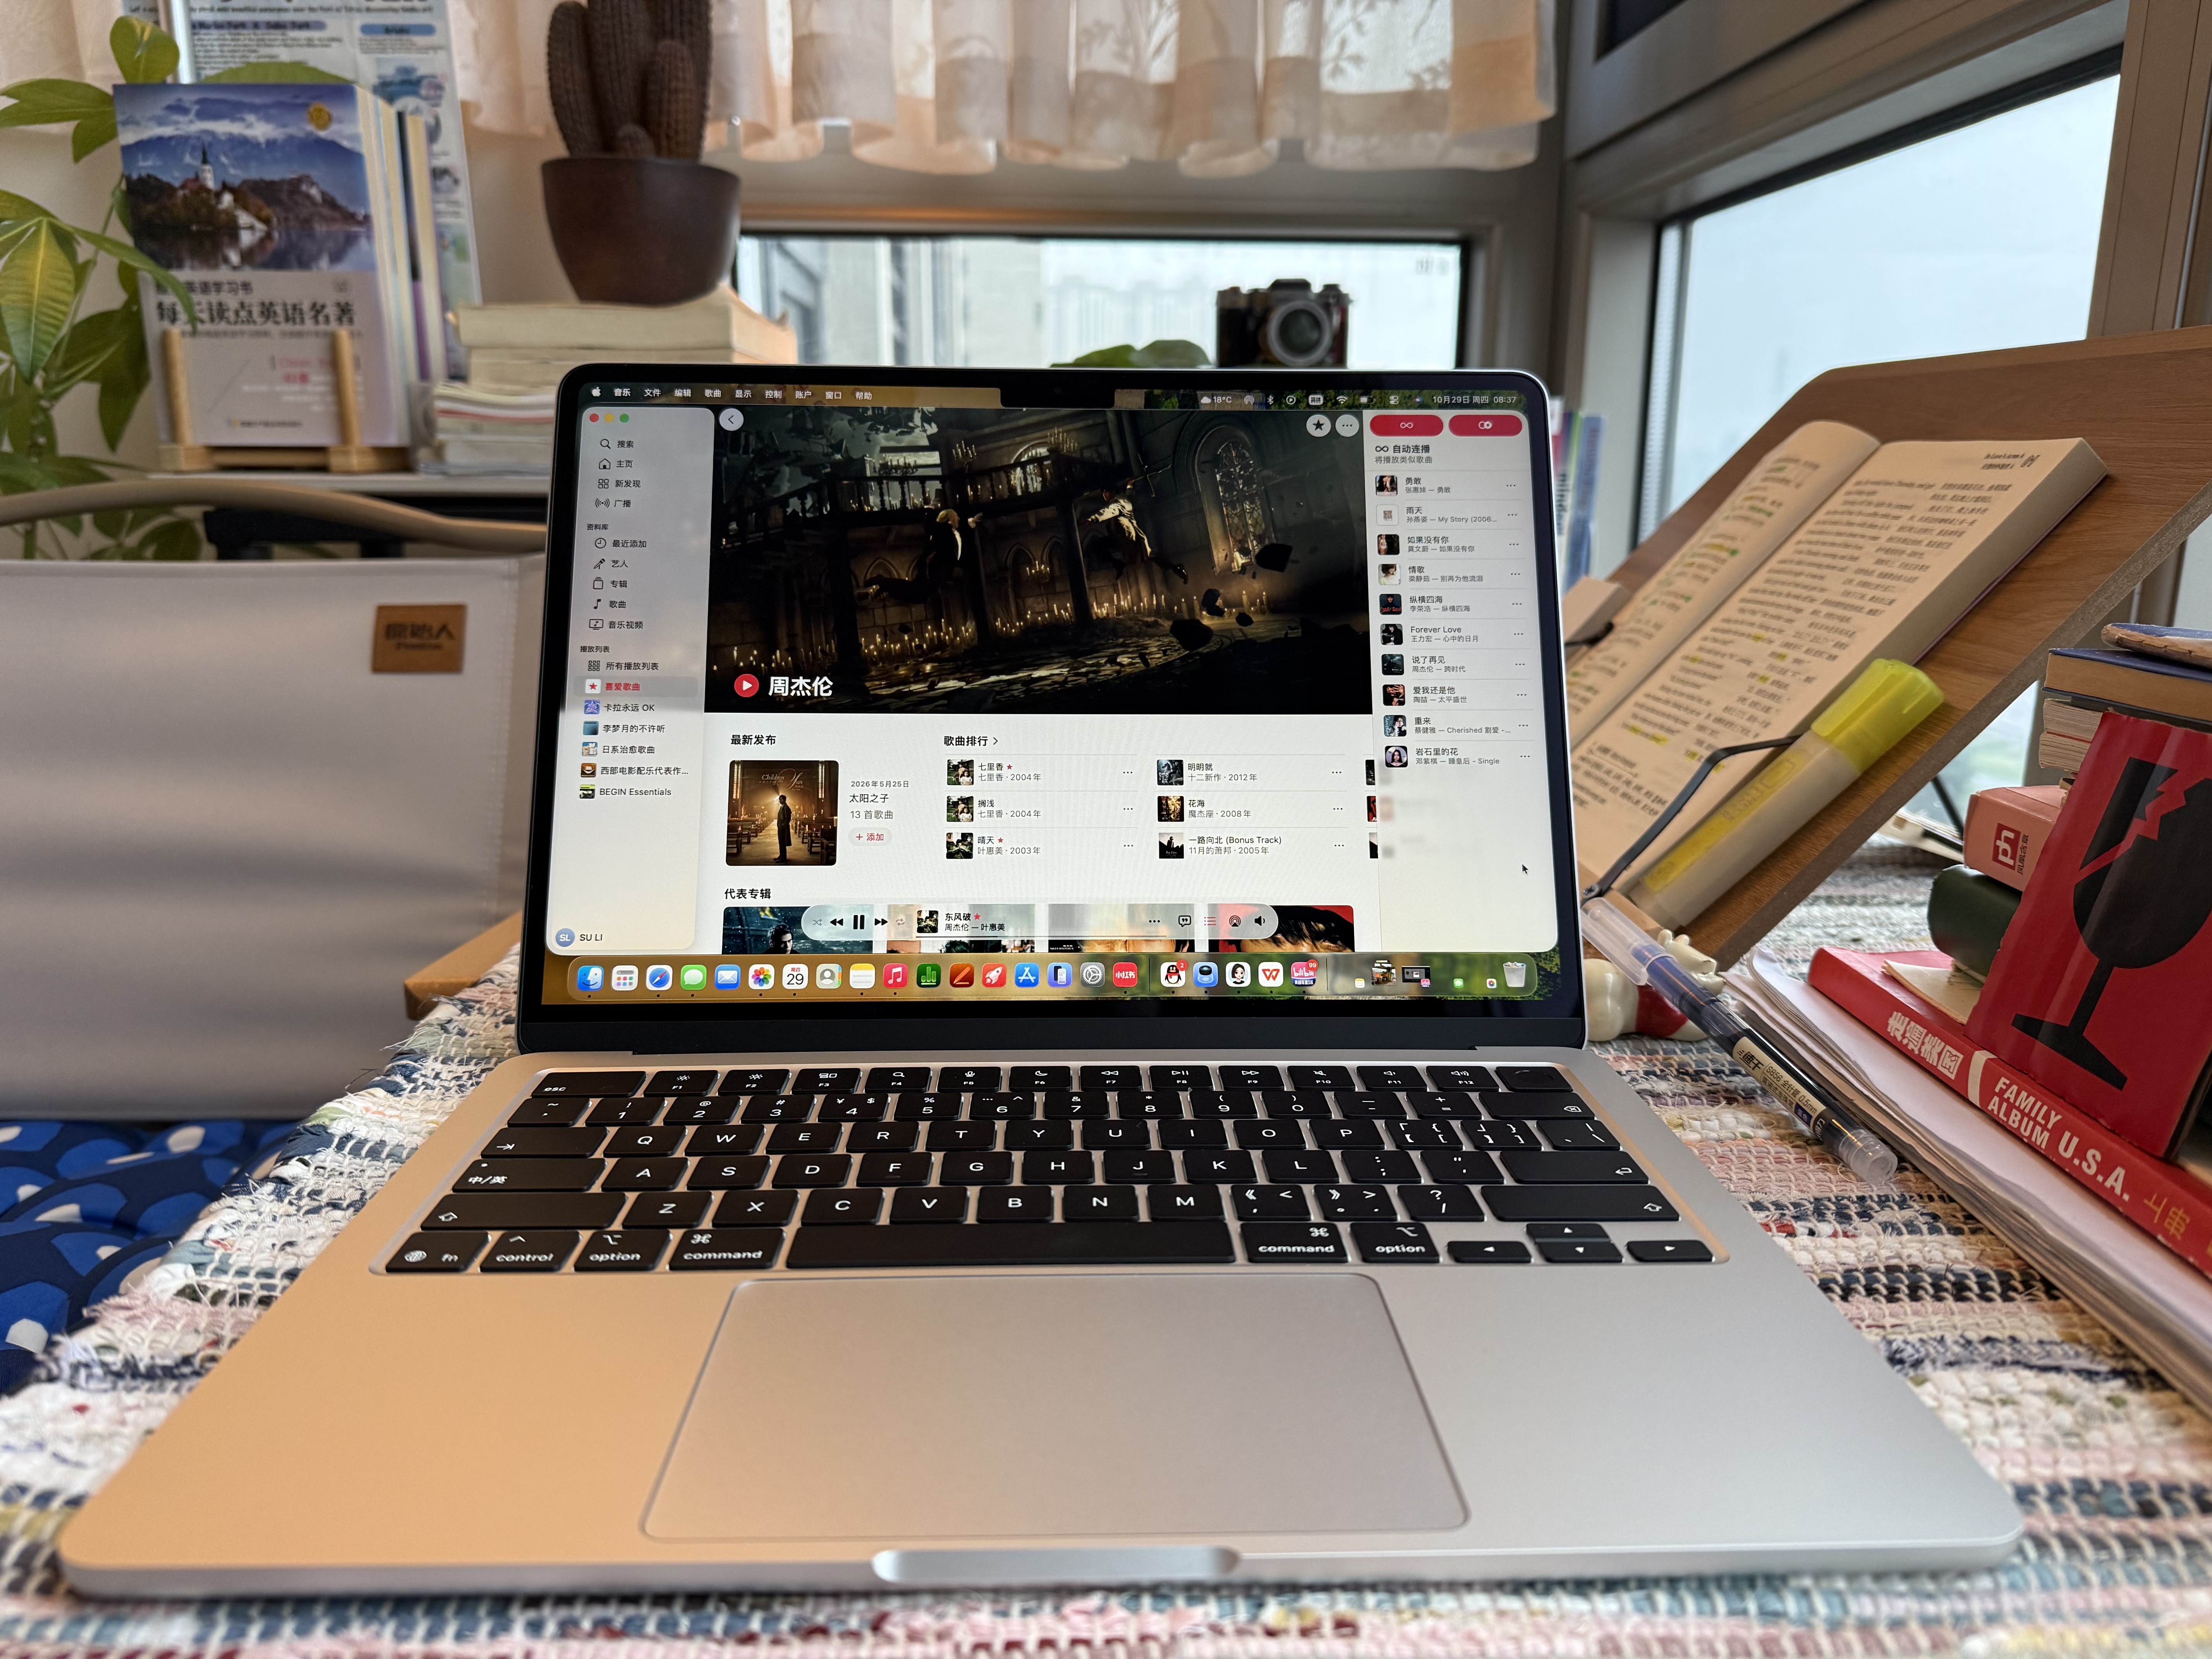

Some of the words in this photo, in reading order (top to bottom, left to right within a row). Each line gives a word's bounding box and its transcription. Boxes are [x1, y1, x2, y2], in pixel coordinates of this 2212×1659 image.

[614, 388, 631, 397] 音乐
[644, 389, 661, 397] 文件
[674, 389, 692, 397] 编辑
[705, 390, 721, 398] 歌曲
[735, 390, 752, 398] 显示
[765, 390, 782, 399] 控制
[795, 391, 812, 399] 账户
[825, 391, 842, 400] 窗口
[855, 392, 872, 400] 帮助
[1432, 396, 1469, 404] 10月29日
[1472, 396, 1489, 404] 周四
[617, 440, 634, 448] 搜索
[1393, 445, 1430, 453] 自动连播
[615, 479, 641, 488] 新发现
[1405, 477, 1421, 485] 勇敢
[614, 499, 631, 508] 广播
[612, 540, 647, 548] 最近添加
[1407, 536, 1449, 544] 如果没有你
[612, 560, 629, 568] 艺人
[1408, 566, 1425, 574] 情歌
[1409, 596, 1443, 604] 纵横四海
[609, 601, 626, 609] 歌曲
[608, 621, 643, 629] 音乐视频
[1412, 656, 1446, 664] 说了再见
[606, 662, 659, 671] 所有播放列表
[605, 683, 640, 691] 喜爱歌曲
[768, 676, 833, 697] 周杰伦
[1413, 686, 1455, 694] 爱我还是他
[1414, 717, 1431, 725] 重来
[603, 725, 665, 733] 李梦月的不许听
[731, 735, 776, 745] 最新发布
[944, 736, 988, 746] 歌曲排行
[603, 746, 655, 754] 日系治愈歌曲
[1415, 748, 1458, 756] 岩石里的花
[978, 763, 1004, 771] 七里香
[1188, 763, 1213, 771] 明明就
[1188, 773, 1221, 781] 十二新作
[1228, 773, 1257, 781] 2012年
[849, 794, 889, 803] 太阳之子
[977, 799, 995, 807] 搁浅
[1188, 799, 1205, 807] 花海
[864, 810, 893, 819] 首歌曲
[977, 810, 1003, 818] 七里香
[1010, 810, 1041, 818] 2004年
[1188, 810, 1214, 818] 魔杰座
[1221, 810, 1251, 818] 2008年
[866, 833, 884, 841] 添加
[977, 836, 994, 845] 晴天
[1188, 836, 1223, 845] 一路向北
[1226, 836, 1254, 845] (Bonus
[1257, 836, 1282, 845] Track)
[977, 847, 1003, 855] 叶惠美
[1010, 847, 1041, 855] 2003年
[1996, 829, 2015, 866] ph
[2017, 833, 2030, 875] 凤凰含章
[724, 888, 771, 900] 代表专辑
[945, 913, 971, 921] 东风破
[945, 923, 969, 931] 周杰伦
[981, 923, 1005, 931] 叶惠美
[787, 974, 804, 985] 29
[1887, 1011, 1964, 1080] 走遍美国
[1740, 1051, 1764, 1070] 速干
[1781, 1080, 1801, 1098] 全针管
[1798, 1095, 1817, 1114] 0.5mm
[1994, 1077, 2062, 1129] FAMILY
[1987, 1097, 2051, 1150] ALBUM
[637, 1136, 653, 1145] Q
[716, 1135, 736, 1143] W
[1212, 1161, 1227, 1170] K
[2058, 1131, 2130, 1202] U.S.A.
[721, 1167, 737, 1176] S
[1008, 1198, 1022, 1208] B
[1176, 1197, 1195, 1206] M
[1258, 1245, 1335, 1253] command
[1375, 1245, 1426, 1254] option
[441, 1253, 459, 1262] fn
[496, 1252, 554, 1262] control
[589, 1252, 641, 1262] option
[683, 1250, 763, 1260] command
